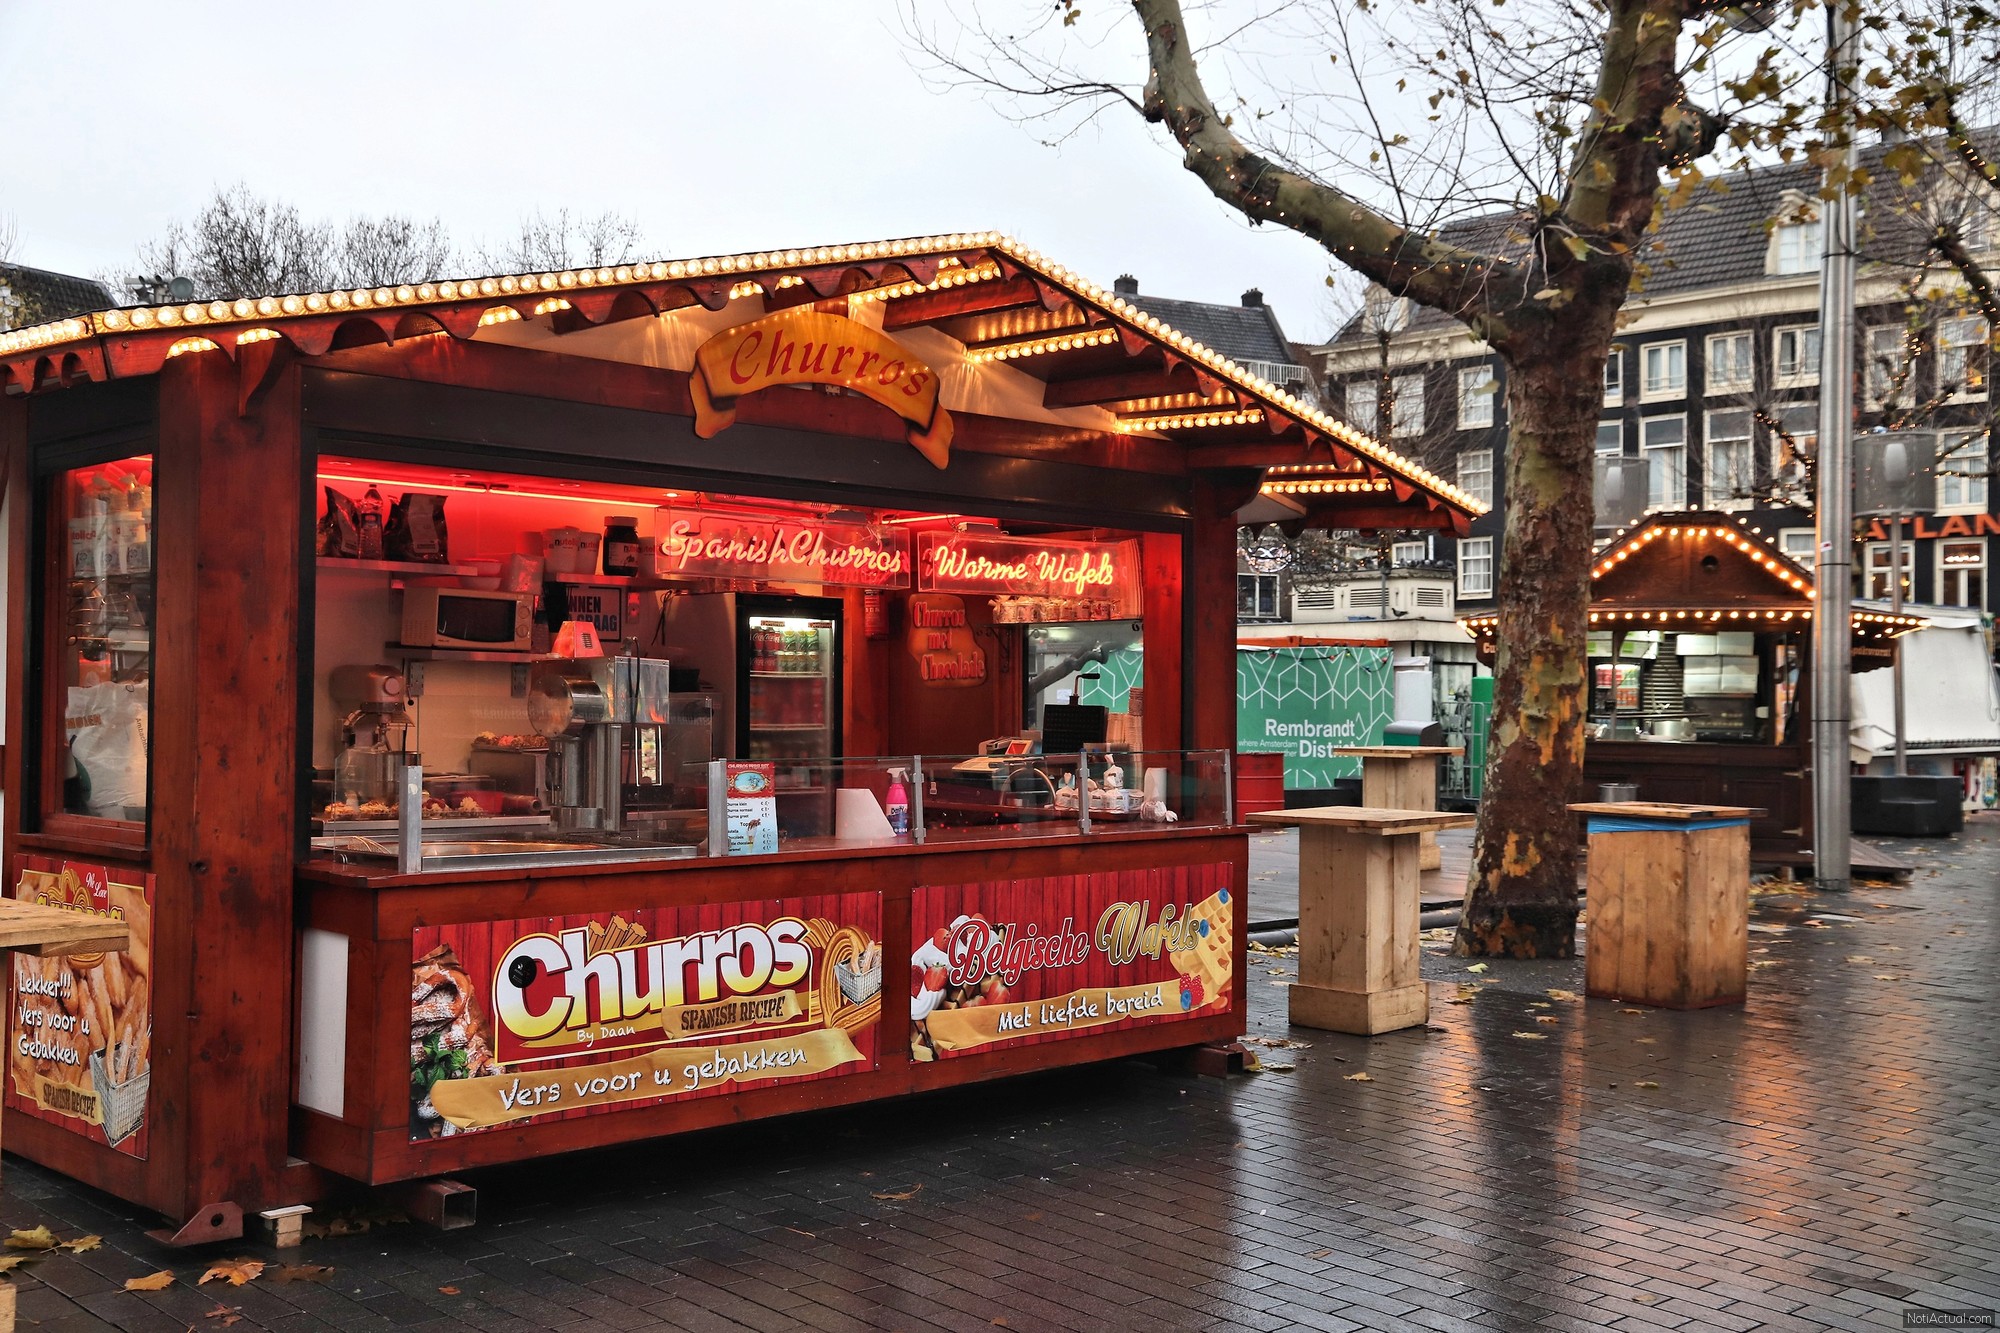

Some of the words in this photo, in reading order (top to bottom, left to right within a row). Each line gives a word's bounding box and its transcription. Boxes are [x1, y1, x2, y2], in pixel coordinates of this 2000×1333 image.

[729, 329, 930, 397] Churros
[934, 545, 1028, 580] Warme
[1036, 551, 1114, 595] Wafels
[569, 595, 602, 613] NNEN
[914, 602, 965, 628] Churros
[928, 630, 953, 650] met
[920, 652, 984, 681] Chocolade
[1260, 738, 1298, 748] Amsterdam
[1265, 719, 1355, 738] Rembrandt
[948, 917, 1090, 986] Belgische
[1095, 900, 1201, 966] Wafels
[19, 971, 72, 999] Lekker!!!
[496, 917, 810, 1039] Churros
[19, 1000, 43, 1027] Vers
[48, 1013, 77, 1033] voor
[81, 1018, 91, 1036] u
[681, 1003, 737, 1031] SPANISH
[738, 995, 787, 1022] RECIPE
[998, 1006, 1032, 1033] Met
[1040, 996, 1099, 1027] liefde
[1105, 986, 1164, 1016] bereid
[18, 1033, 81, 1067] Gebakken
[576, 1028, 595, 1044] By
[600, 1025, 636, 1039] Daan
[498, 1078, 561, 1111] Vers
[573, 1069, 642, 1099] voor
[654, 1067, 672, 1086] u
[683, 1047, 808, 1092] gebakken
[43, 1083, 71, 1109] SPANISH
[71, 1093, 97, 1119] RECIPE
